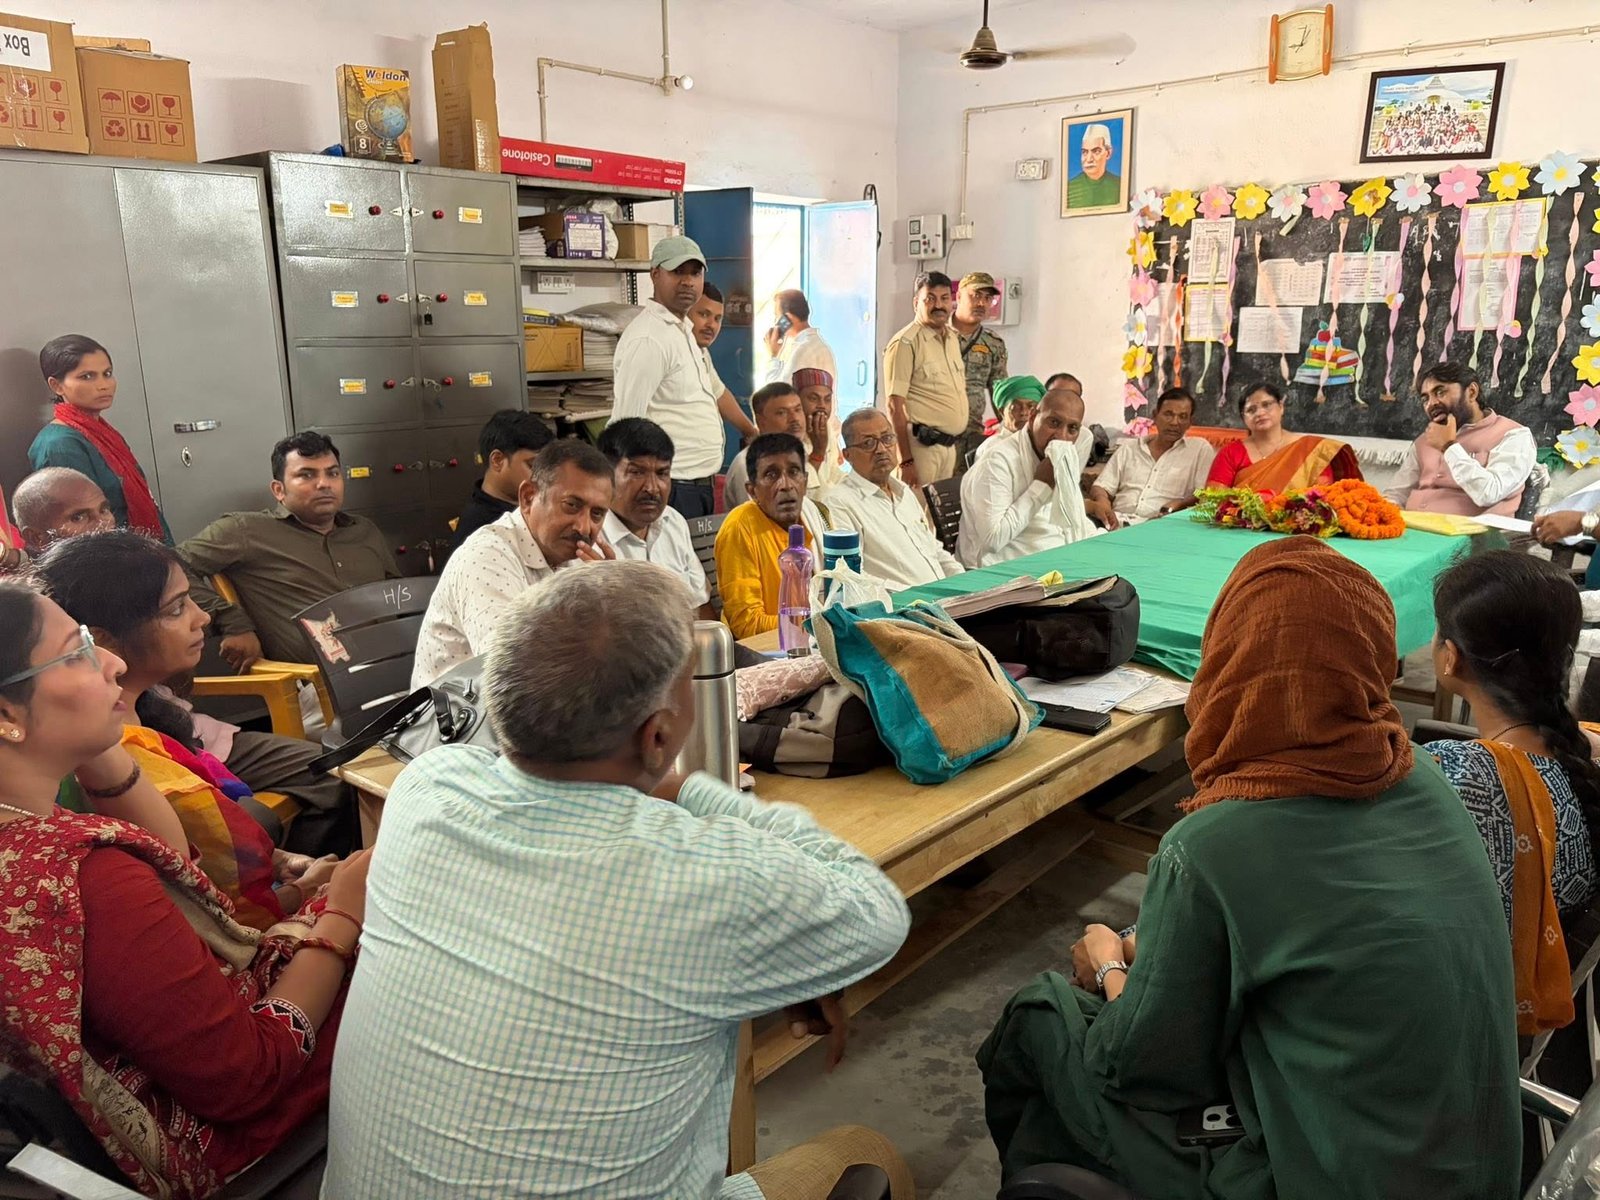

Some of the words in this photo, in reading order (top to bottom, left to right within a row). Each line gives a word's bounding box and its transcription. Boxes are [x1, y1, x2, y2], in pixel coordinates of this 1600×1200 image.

[3, 33, 31, 57] Box
[365, 69, 406, 82] Weldon
[359, 138, 367, 149] 8
[502, 148, 551, 166] Casiotone
[697, 518, 713, 533] H/S
[383, 584, 412, 610] H/S
